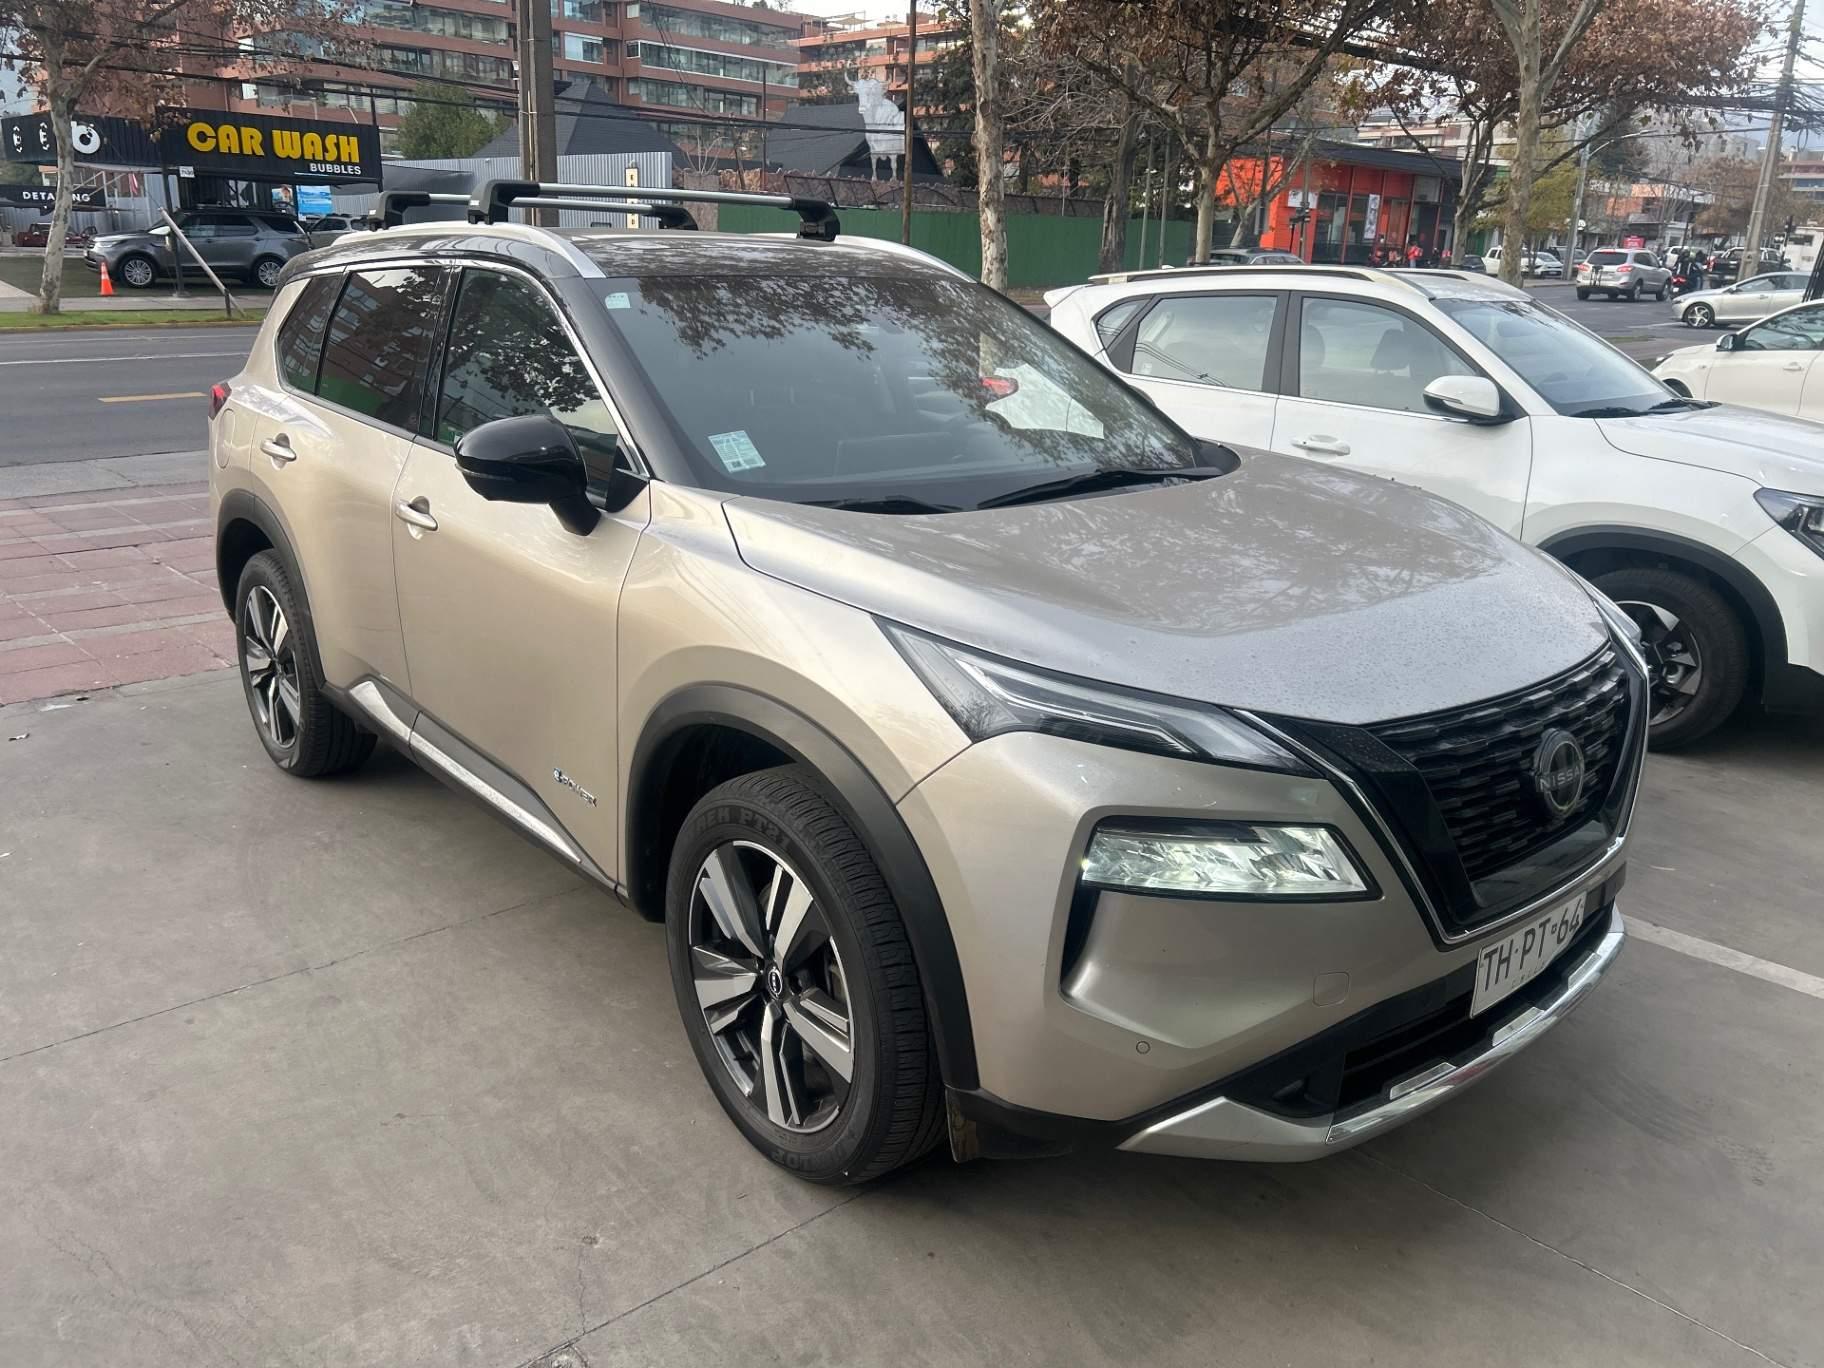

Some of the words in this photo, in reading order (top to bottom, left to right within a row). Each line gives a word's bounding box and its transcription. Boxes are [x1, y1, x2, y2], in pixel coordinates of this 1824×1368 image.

[187, 122, 264, 156] CAR
[272, 129, 360, 163] WASH
[310, 163, 362, 175] BUBBLES
[22, 191, 91, 202] DETANG
